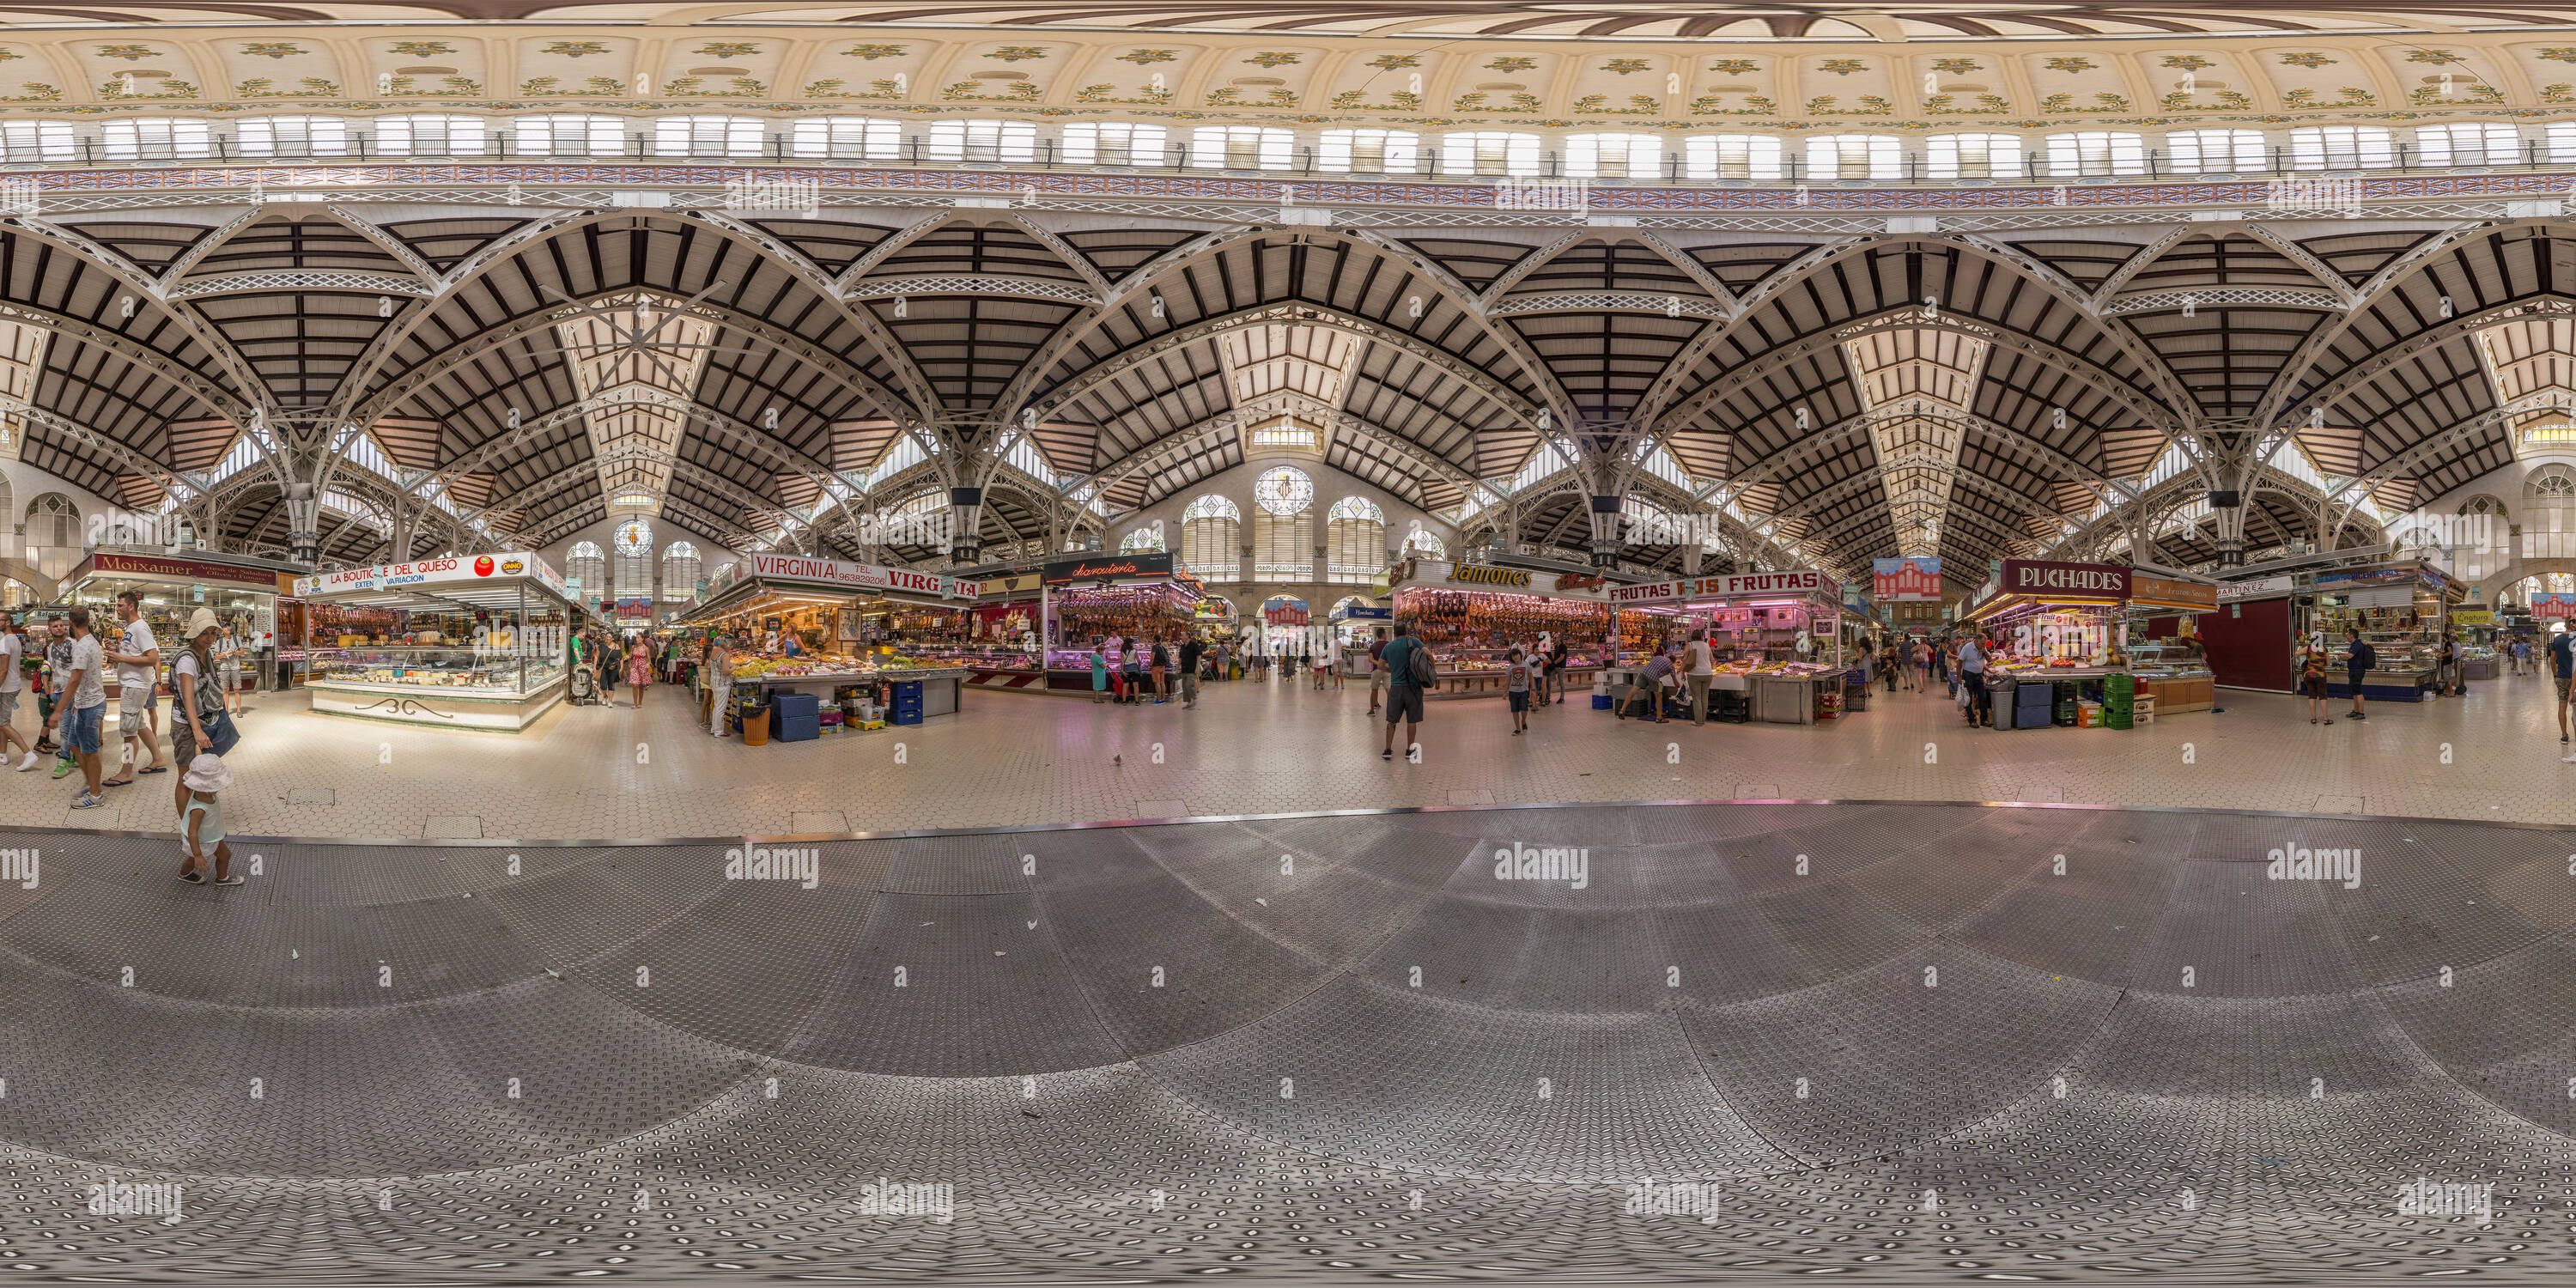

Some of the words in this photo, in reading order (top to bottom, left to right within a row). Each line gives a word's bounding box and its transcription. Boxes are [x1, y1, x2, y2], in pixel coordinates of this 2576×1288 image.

[102, 556, 193, 575] Moixamer
[331, 574, 342, 584] LA
[344, 565, 388, 582] BOUTIE
[394, 562, 413, 576] DEL
[418, 559, 458, 573] QUESO
[756, 556, 835, 579] VIRGINIA
[854, 565, 872, 574] TEL:
[1448, 561, 1533, 586] Jamones
[386, 574, 424, 585] VARIACION
[838, 573, 885, 585] 963829206
[888, 570, 978, 597] VIRGNIA
[1610, 584, 1670, 601] FRUTAS
[1729, 573, 1817, 592] FRUTAS
[2020, 567, 2123, 592] PUCHADES
[2216, 584, 2264, 596] MARTINEZ
